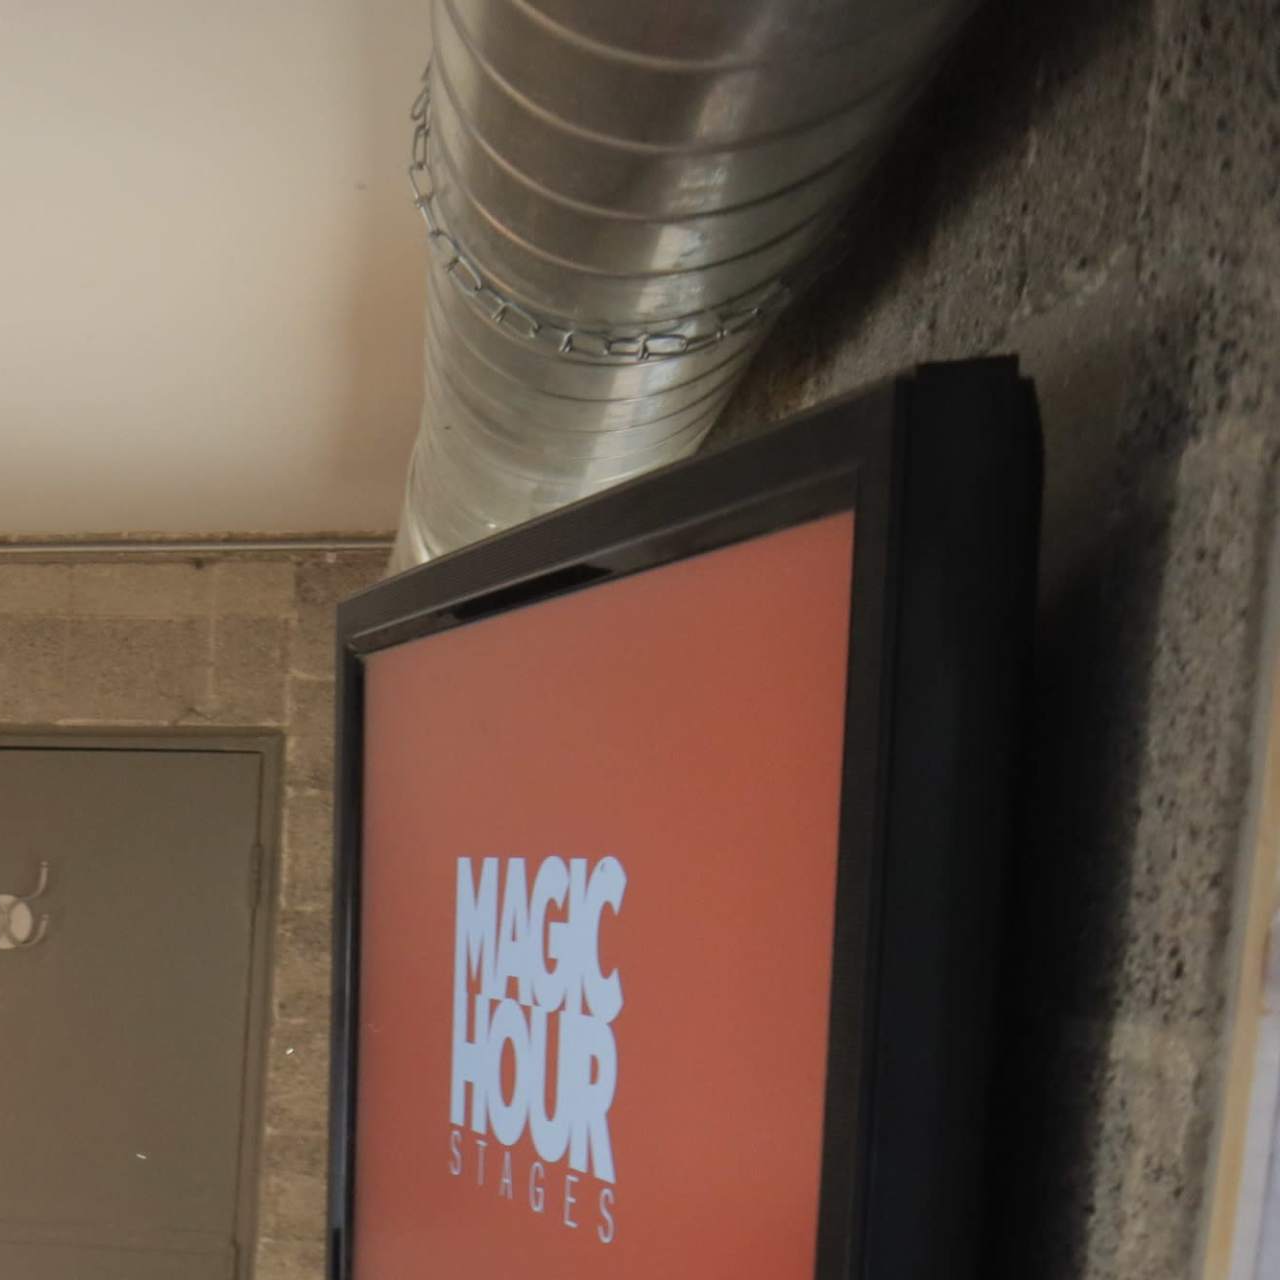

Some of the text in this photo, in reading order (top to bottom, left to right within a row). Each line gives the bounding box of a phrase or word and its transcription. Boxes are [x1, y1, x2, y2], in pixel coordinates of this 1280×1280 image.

[455, 856, 628, 1024] MAGIC
[450, 994, 618, 1184] HOUR
[449, 1131, 616, 1244] STAGES
